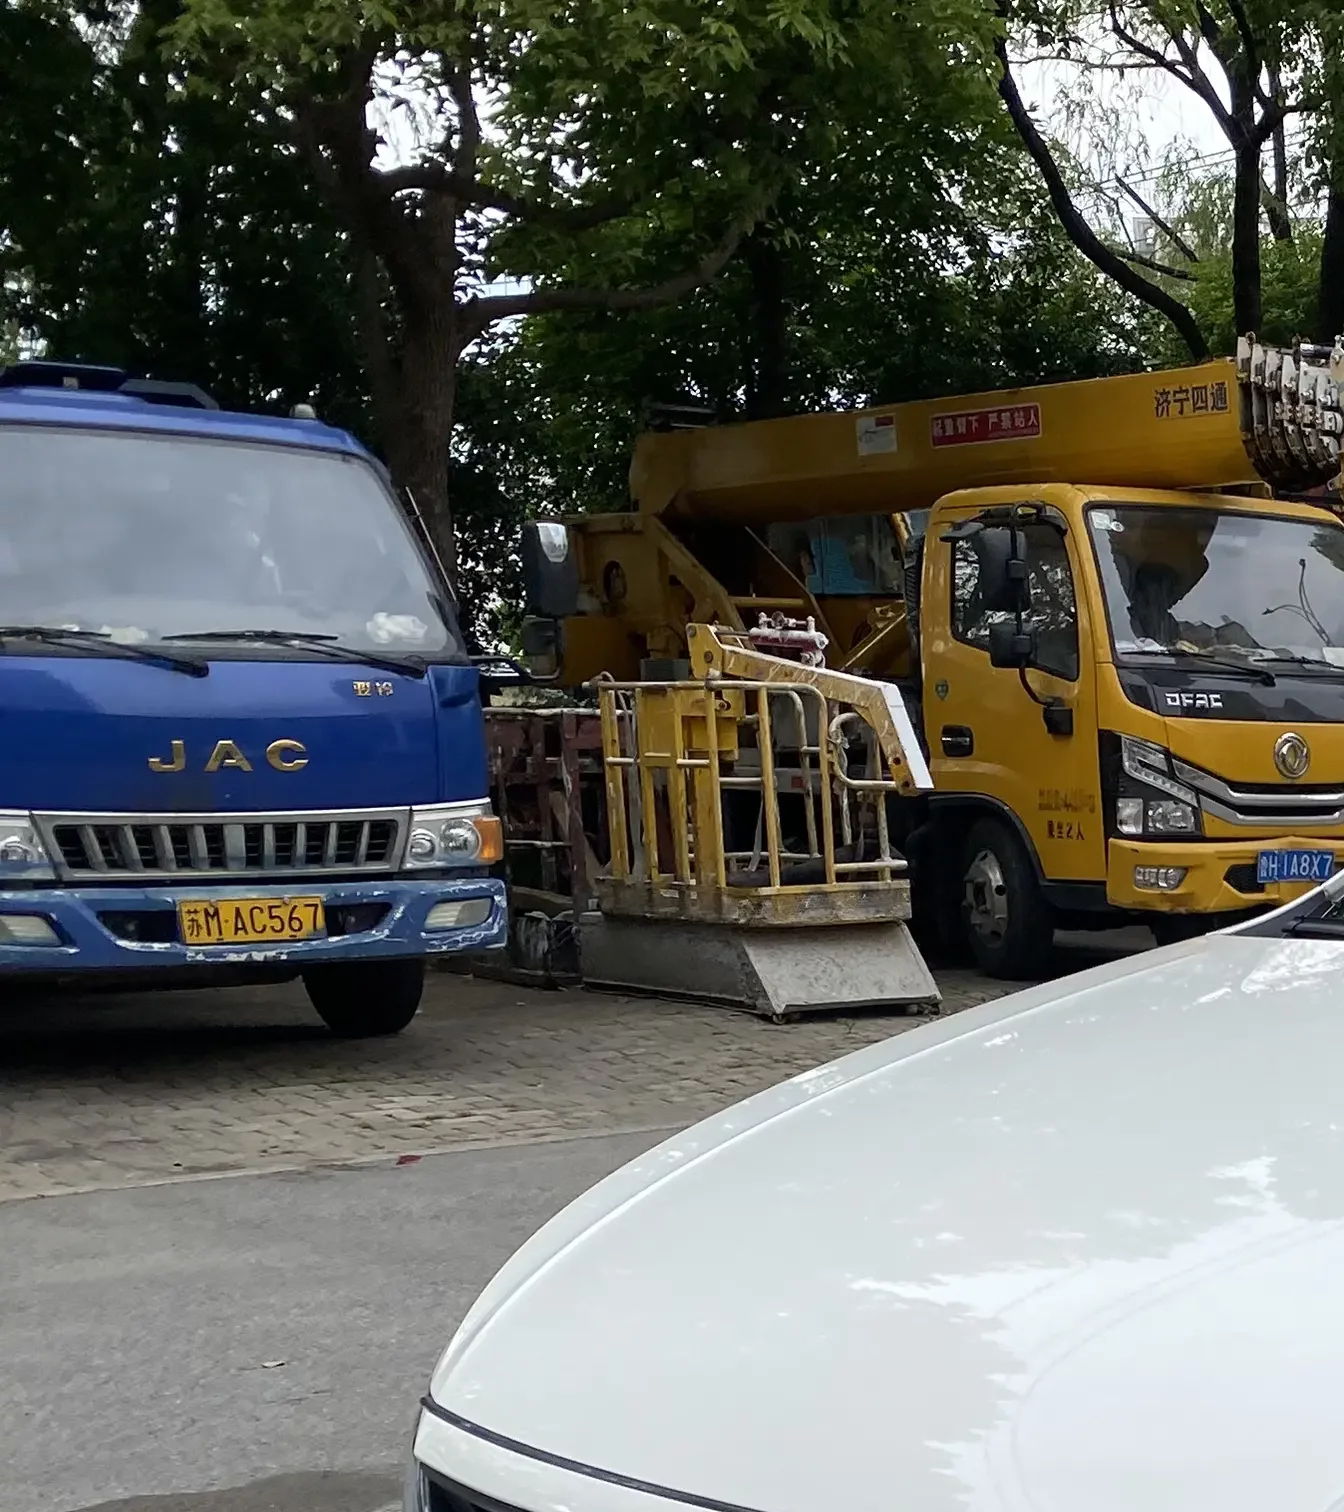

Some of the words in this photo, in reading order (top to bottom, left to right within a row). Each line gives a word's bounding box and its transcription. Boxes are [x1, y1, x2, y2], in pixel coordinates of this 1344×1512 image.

[1153, 381, 1229, 418] 济宁四通
[1165, 692, 1223, 708] DFAC
[148, 739, 309, 772] JAC
